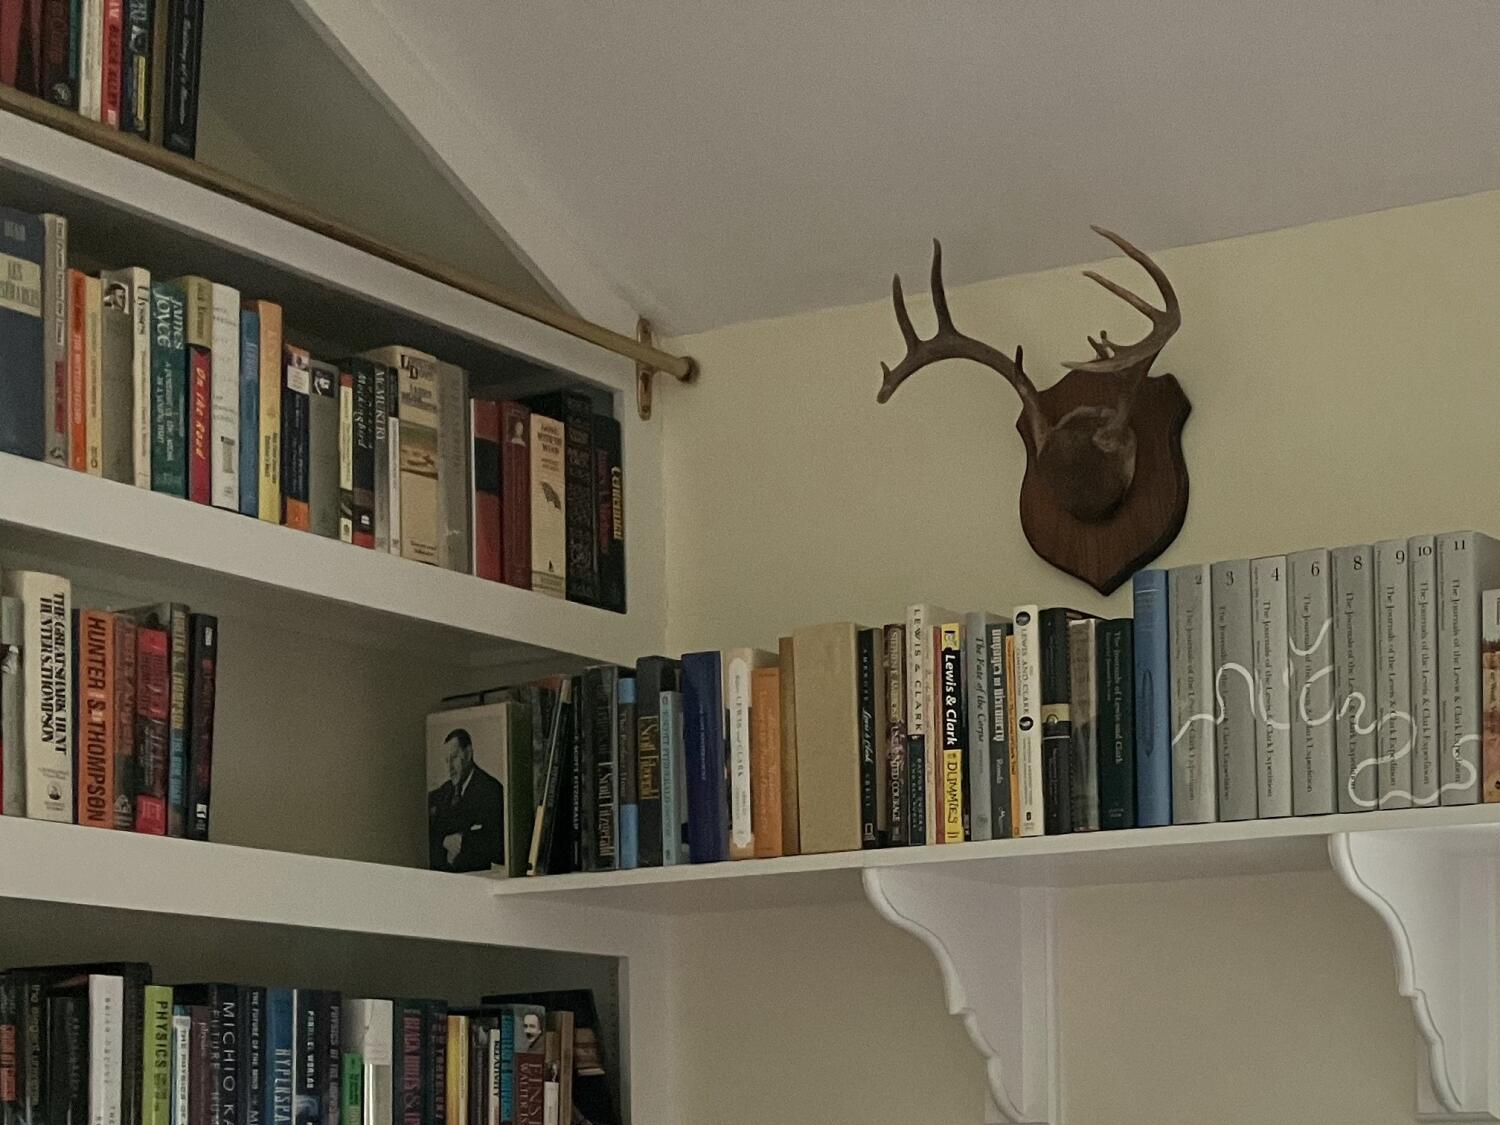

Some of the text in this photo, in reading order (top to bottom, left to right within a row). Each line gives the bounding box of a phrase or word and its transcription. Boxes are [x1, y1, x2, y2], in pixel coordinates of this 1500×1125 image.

[194, 418, 208, 460] Road
[1396, 549, 1405, 565] 9
[1418, 545, 1432, 557] 10
[1454, 540, 1465, 551] 11
[1271, 567, 1280, 582] 4
[1311, 561, 1320, 576] 6
[1354, 555, 1363, 571] 8
[1226, 570, 1234, 586] 3
[54, 592, 68, 618] THE
[54, 622, 68, 668] GREAT
[914, 608, 922, 658] LEWIS
[1020, 628, 1028, 658] LEWIS
[1112, 630, 1122, 648] The
[944, 654, 958, 746] Lewis & Clark
[974, 636, 988, 744] The Fate of the Corps
[1022, 684, 1030, 714] CLARK
[914, 678, 922, 732] CLARK
[1114, 698, 1124, 722] Lewis
[86, 616, 106, 822] HUNTER S. THOMPSON
[54, 716, 68, 758] HUNT
[1114, 740, 1124, 766] Clark
[944, 762, 960, 826] DUMMIES
[250, 990, 260, 1006] THE
[154, 1000, 170, 1068] PHYSICS
[250, 1006, 260, 1038] FUTURE
[178, 1028, 188, 1048] THE
[222, 1000, 236, 1092] MICHIO
[250, 1038, 260, 1050] OF
[250, 1052, 260, 1066] THE
[178, 1054, 188, 1100] PHYSICS
[518, 1062, 530, 1110] WALTER
[178, 1104, 188, 1118] OF
[402, 1092, 422, 1110] &
[108, 1104, 116, 1125] THE
